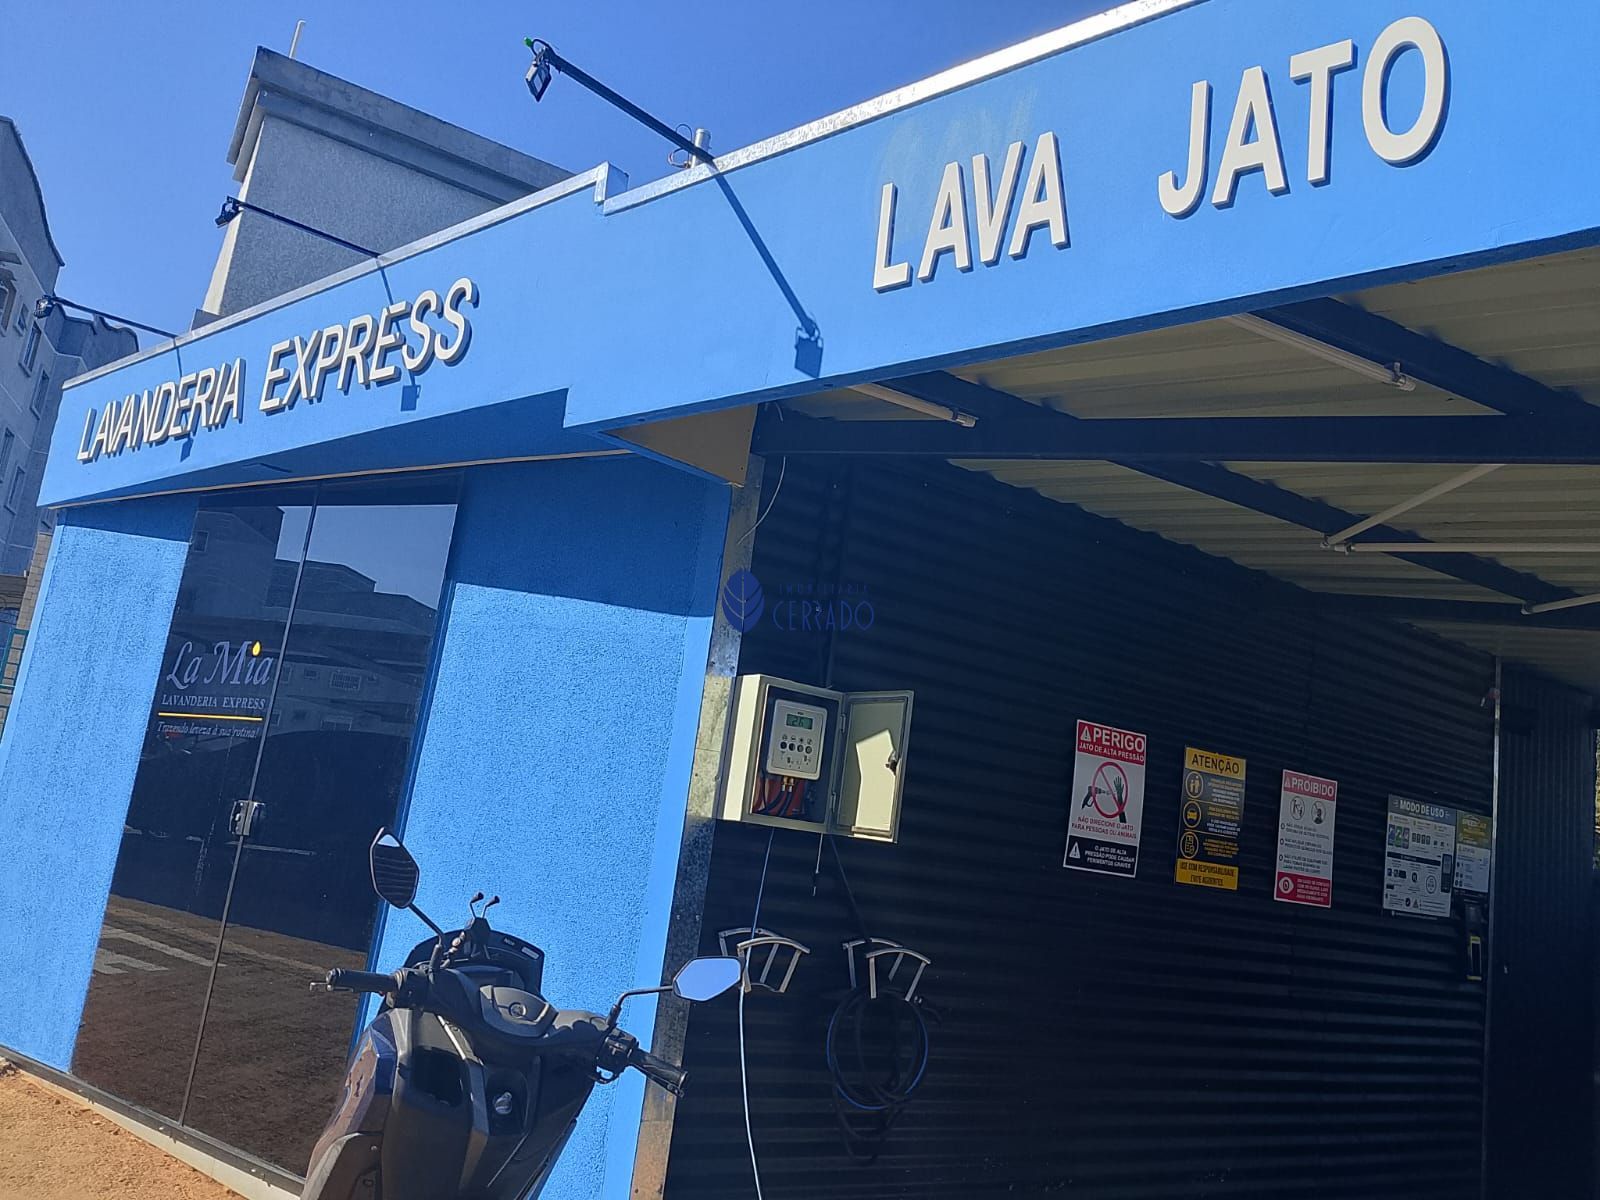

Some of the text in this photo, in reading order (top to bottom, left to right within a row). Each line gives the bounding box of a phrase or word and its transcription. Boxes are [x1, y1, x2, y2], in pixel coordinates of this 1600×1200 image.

[872, 16, 1450, 292] LAVA JATO
[77, 277, 479, 462] LAVANDERIA EXPRESS
[166, 640, 274, 690] La Mia
[161, 694, 266, 710] LAVANDERIA EXPRESS
[1093, 727, 1145, 753] PERIGO
[1079, 742, 1094, 751] JATO
[1104, 748, 1117, 756] ALTA
[1118, 750, 1145, 762] PRESSÃO
[1191, 753, 1240, 774] ATENÇÃO
[1291, 777, 1335, 797] PROIBIDO
[1400, 799, 1421, 813] MODO
[1421, 803, 1430, 815] DE
[1430, 806, 1445, 818] USO
[1072, 822, 1085, 830] PARA
[1085, 825, 1109, 835] PESSOAS
[1117, 830, 1137, 839] ANIMAIS
[1077, 815, 1089, 825] NÃO
[1089, 818, 1116, 828] DIRECIONE
[1121, 823, 1134, 831] JATO
